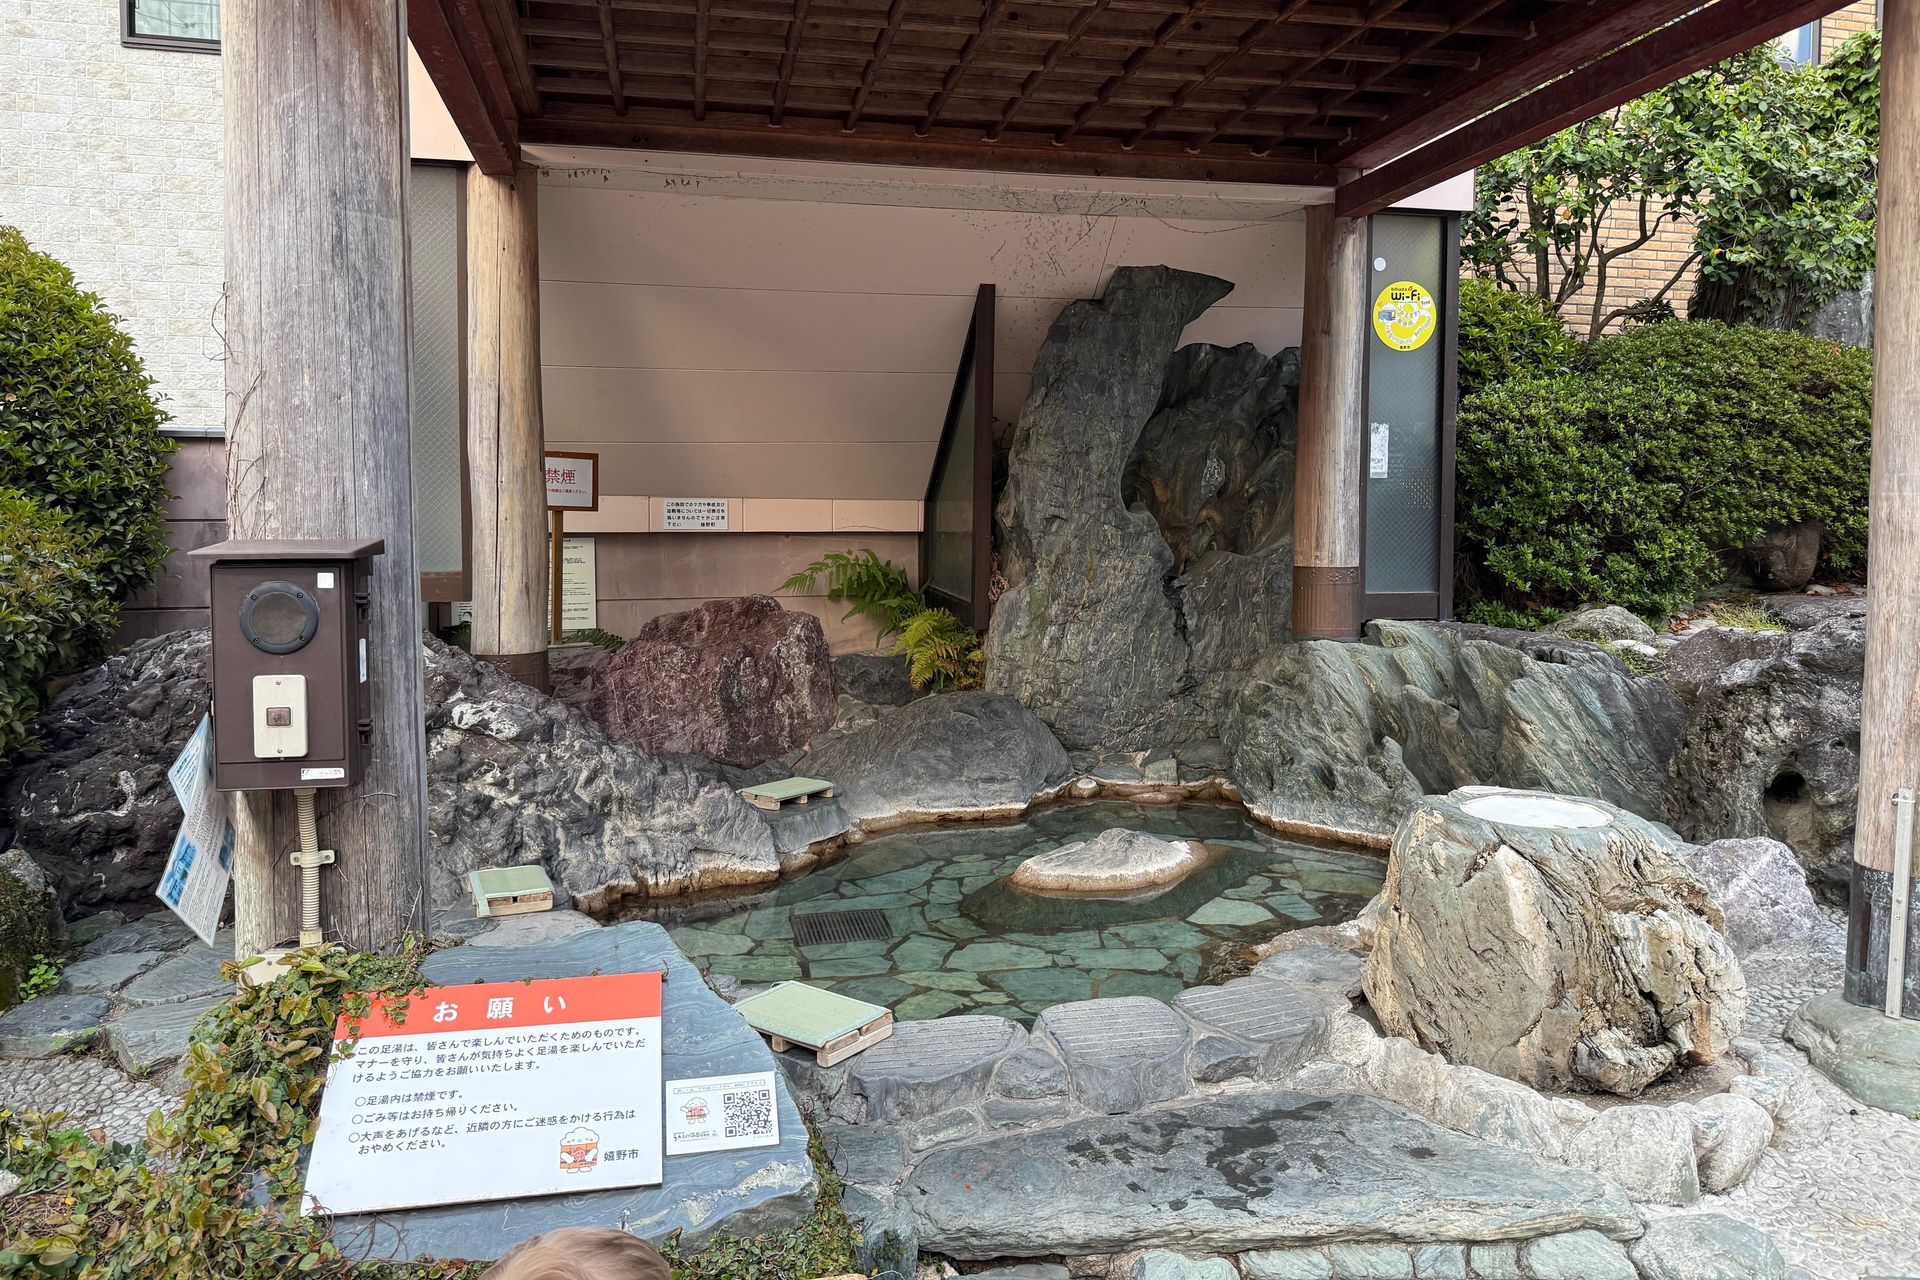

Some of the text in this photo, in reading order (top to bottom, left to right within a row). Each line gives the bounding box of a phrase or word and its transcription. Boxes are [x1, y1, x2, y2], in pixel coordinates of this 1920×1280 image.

[545, 467, 576, 485] 禁煙
[357, 1026, 643, 1057] この足湯は、皆さんで楽しんでいただくためのものです。
[354, 1038, 646, 1070] マナーを守り、皆さんが気持ちよく足湯を楽しんでいただ
[352, 1059, 542, 1083] けるようご協力をお願いいたします。
[357, 1138, 447, 1156] おやめください。
[603, 1148, 640, 1163] 嬉野市
